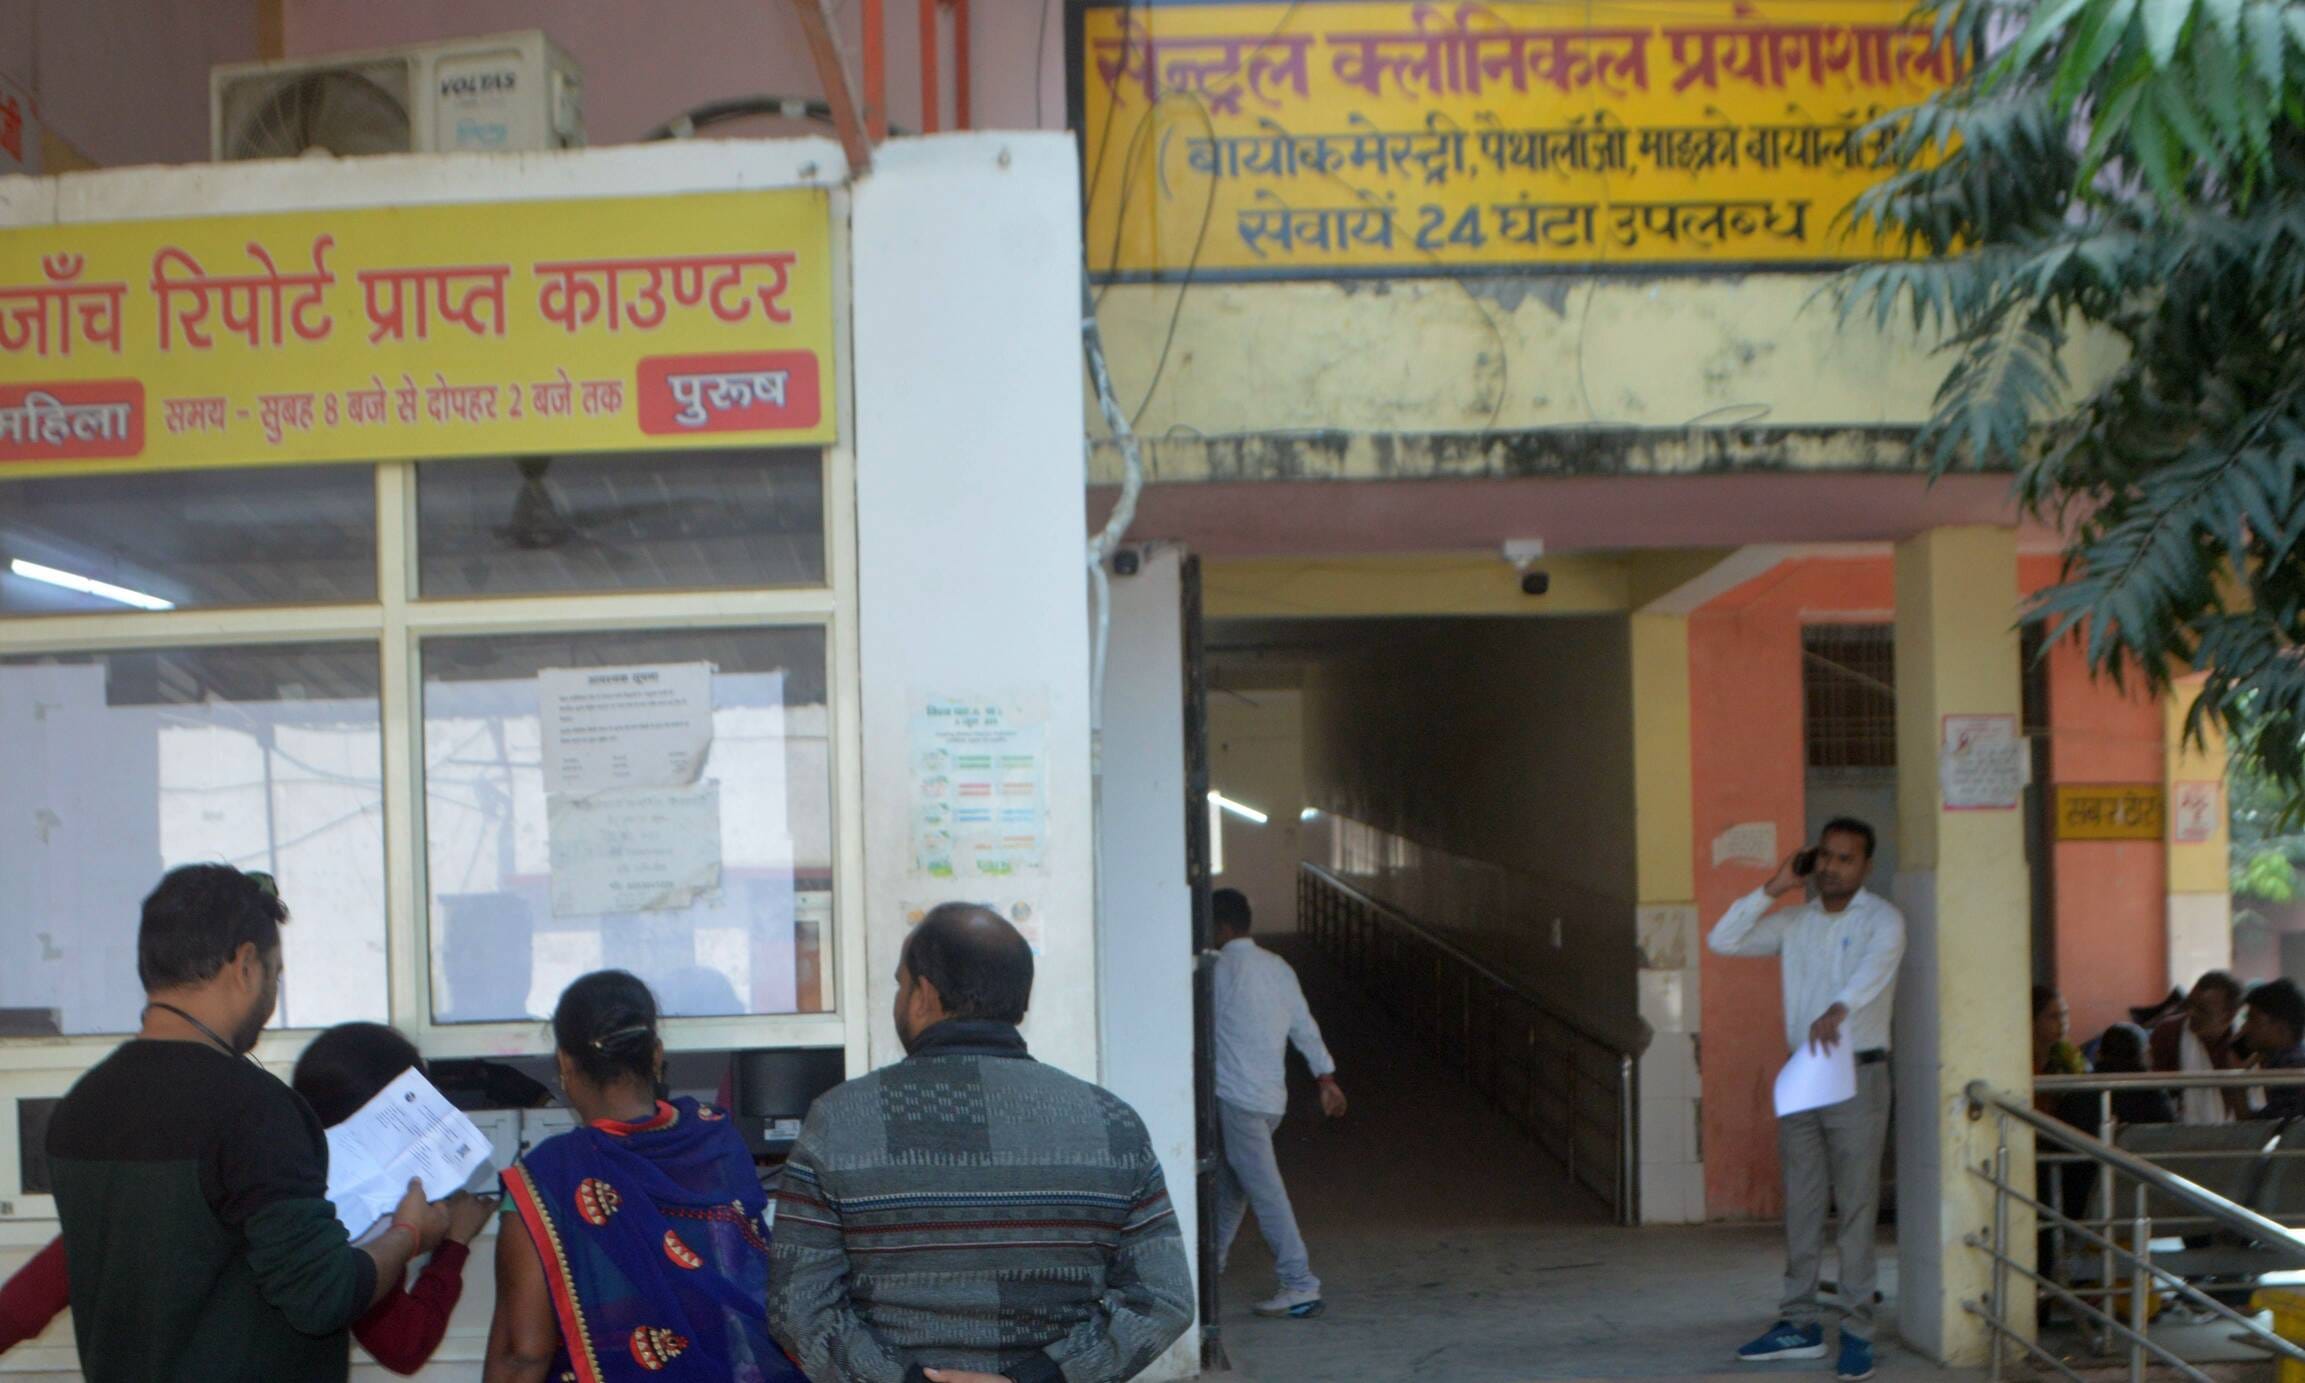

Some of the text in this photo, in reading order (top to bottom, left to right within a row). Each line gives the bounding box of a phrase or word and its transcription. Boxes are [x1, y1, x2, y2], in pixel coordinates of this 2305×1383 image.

[441, 72, 515, 96] VOLTAS
[1415, 204, 1486, 249] 24
[1491, 191, 1598, 246] घंटा
[1607, 200, 1811, 248] उपलब्ध
[0, 234, 797, 356] जाँच रिपोर्ट प्राप्त काउण्टर
[163, 397, 227, 432] समय
[258, 393, 315, 444] सुबह
[325, 393, 338, 426] 8
[347, 376, 387, 422] बजे
[395, 374, 417, 423] से
[426, 373, 498, 422] दोपहर
[508, 384, 523, 417] 2
[532, 367, 572, 417] बजे
[582, 379, 624, 414] तक
[668, 370, 789, 426] पुरूष
